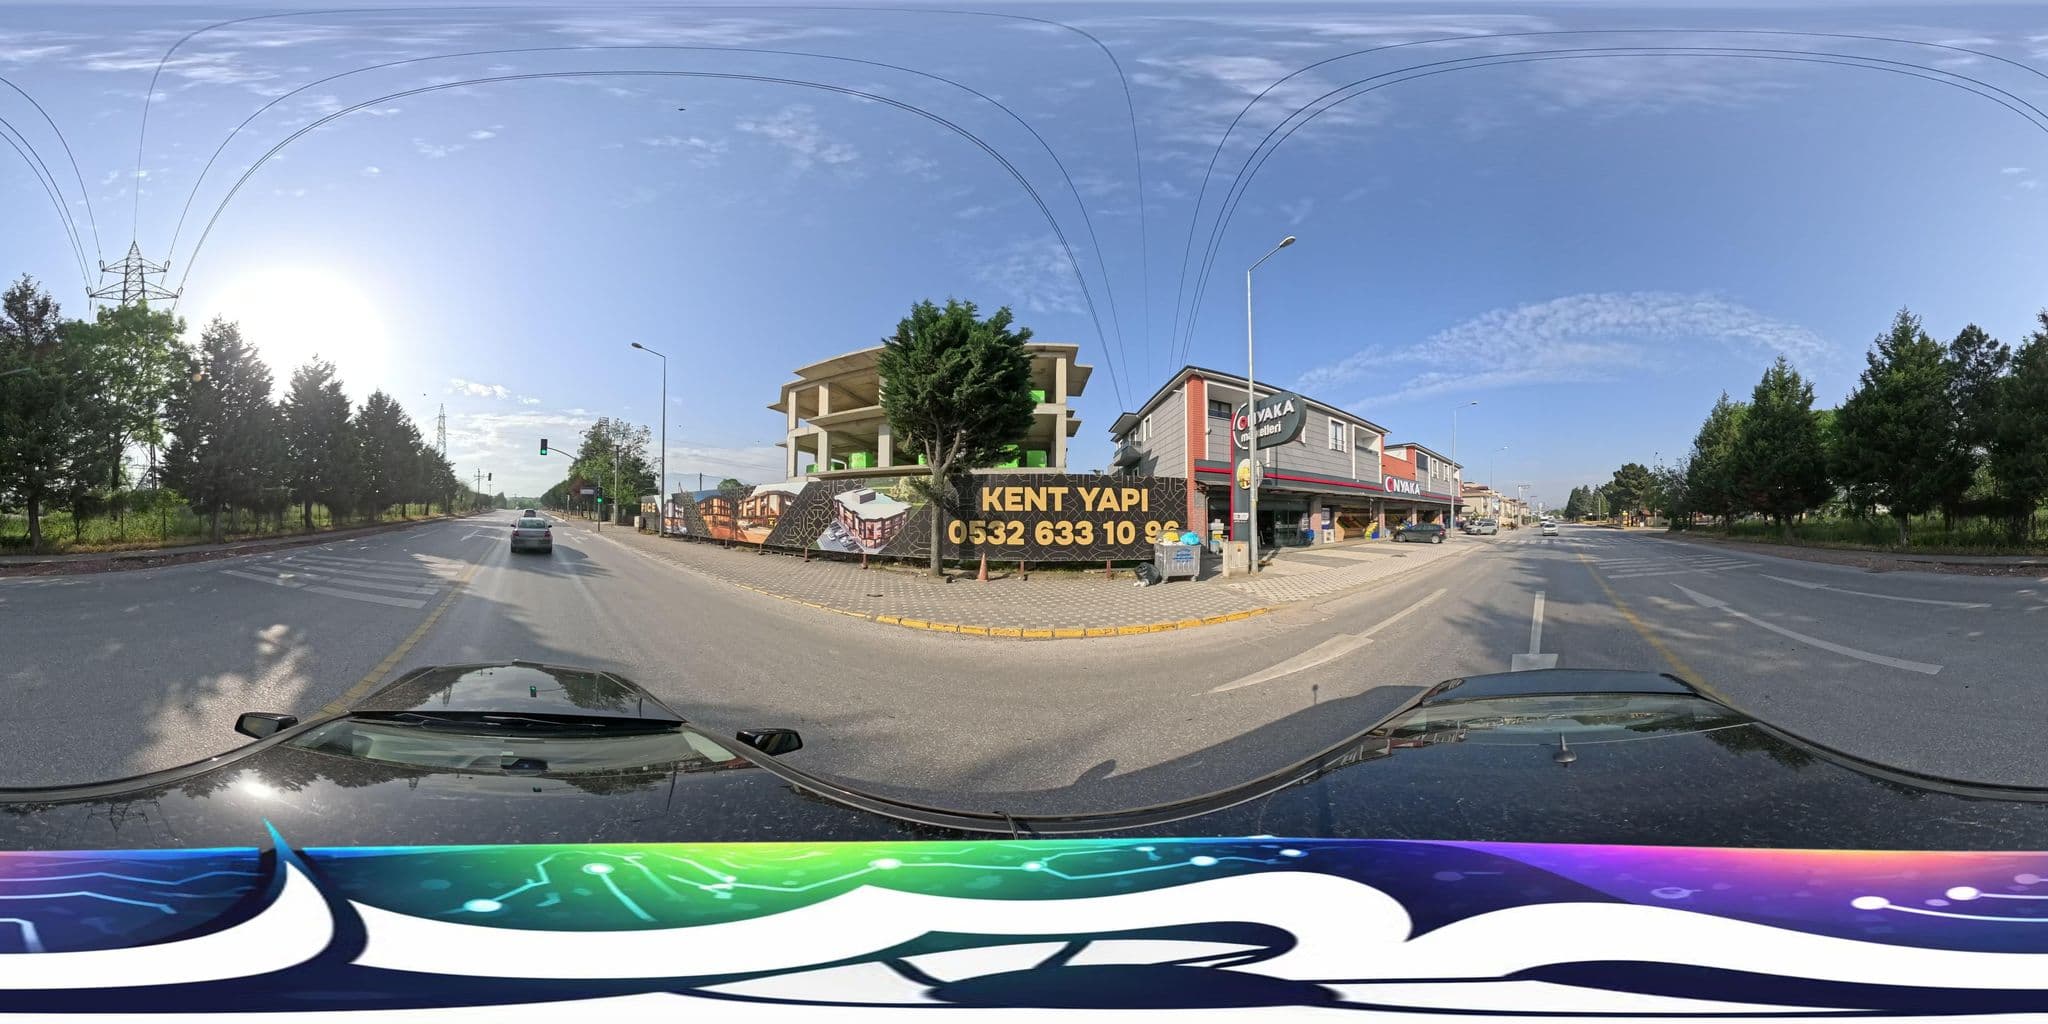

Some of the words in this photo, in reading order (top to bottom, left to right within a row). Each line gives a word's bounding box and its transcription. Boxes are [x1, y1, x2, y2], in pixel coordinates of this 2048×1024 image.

[1240, 421, 1282, 443] metleri
[1385, 476, 1421, 496] ONYAKA
[982, 486, 1068, 512] KENT
[1078, 488, 1149, 512] YAPI
[948, 520, 1025, 545] 0532
[1034, 521, 1094, 545] 633
[1103, 521, 1136, 545] 10
